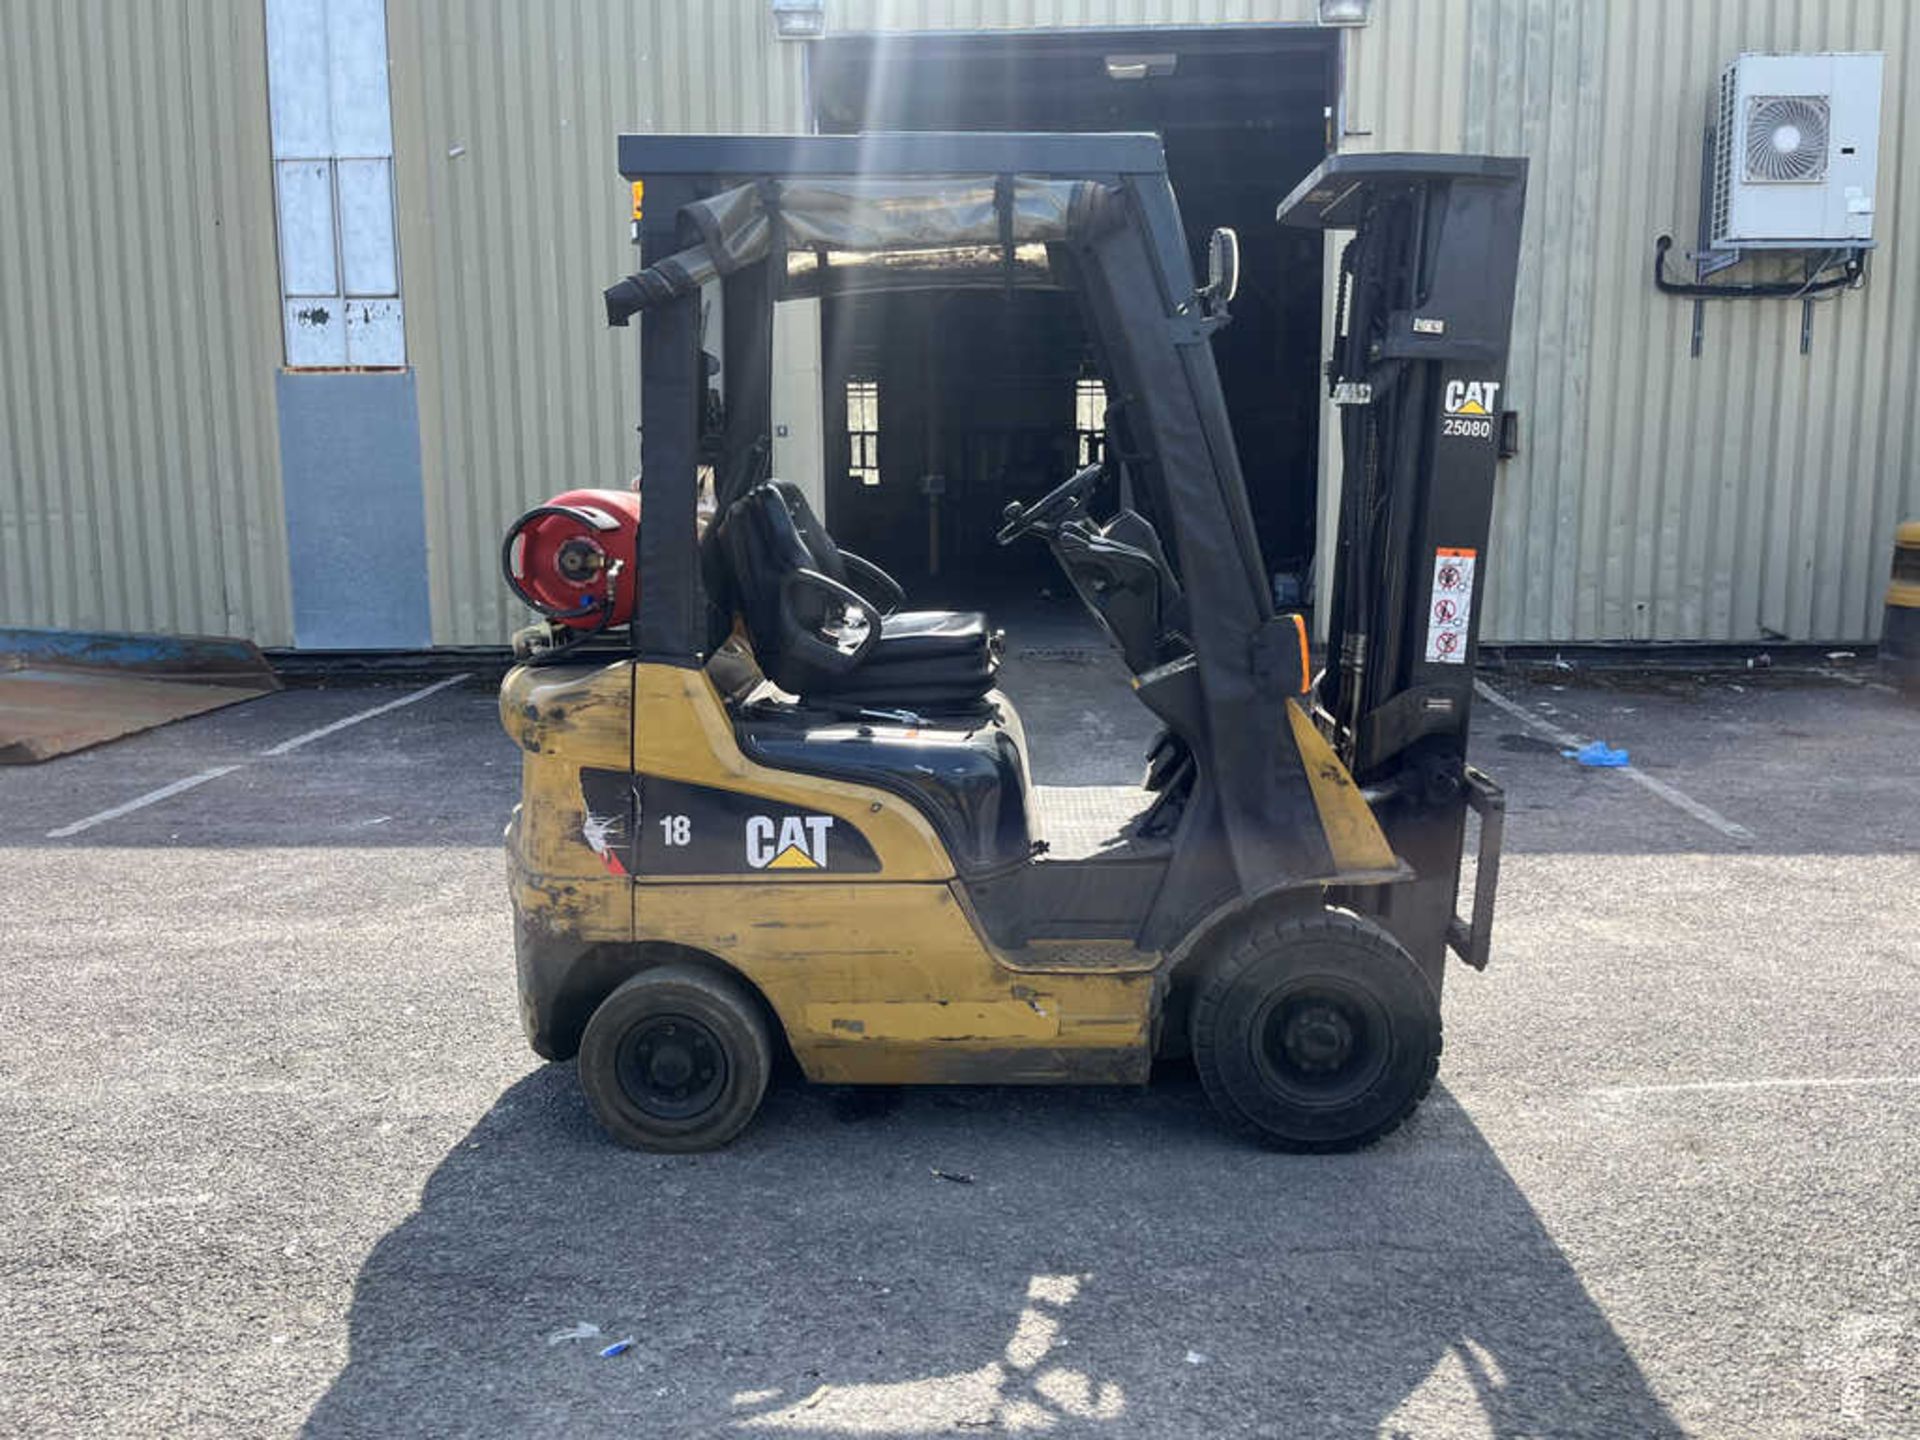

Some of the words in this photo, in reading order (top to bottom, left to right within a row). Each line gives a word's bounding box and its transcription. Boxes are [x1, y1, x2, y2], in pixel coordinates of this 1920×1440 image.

[1445, 380, 1500, 414] CAT
[1443, 419, 1490, 438] 25080
[660, 815, 691, 846] 18
[745, 815, 833, 868] CAT
